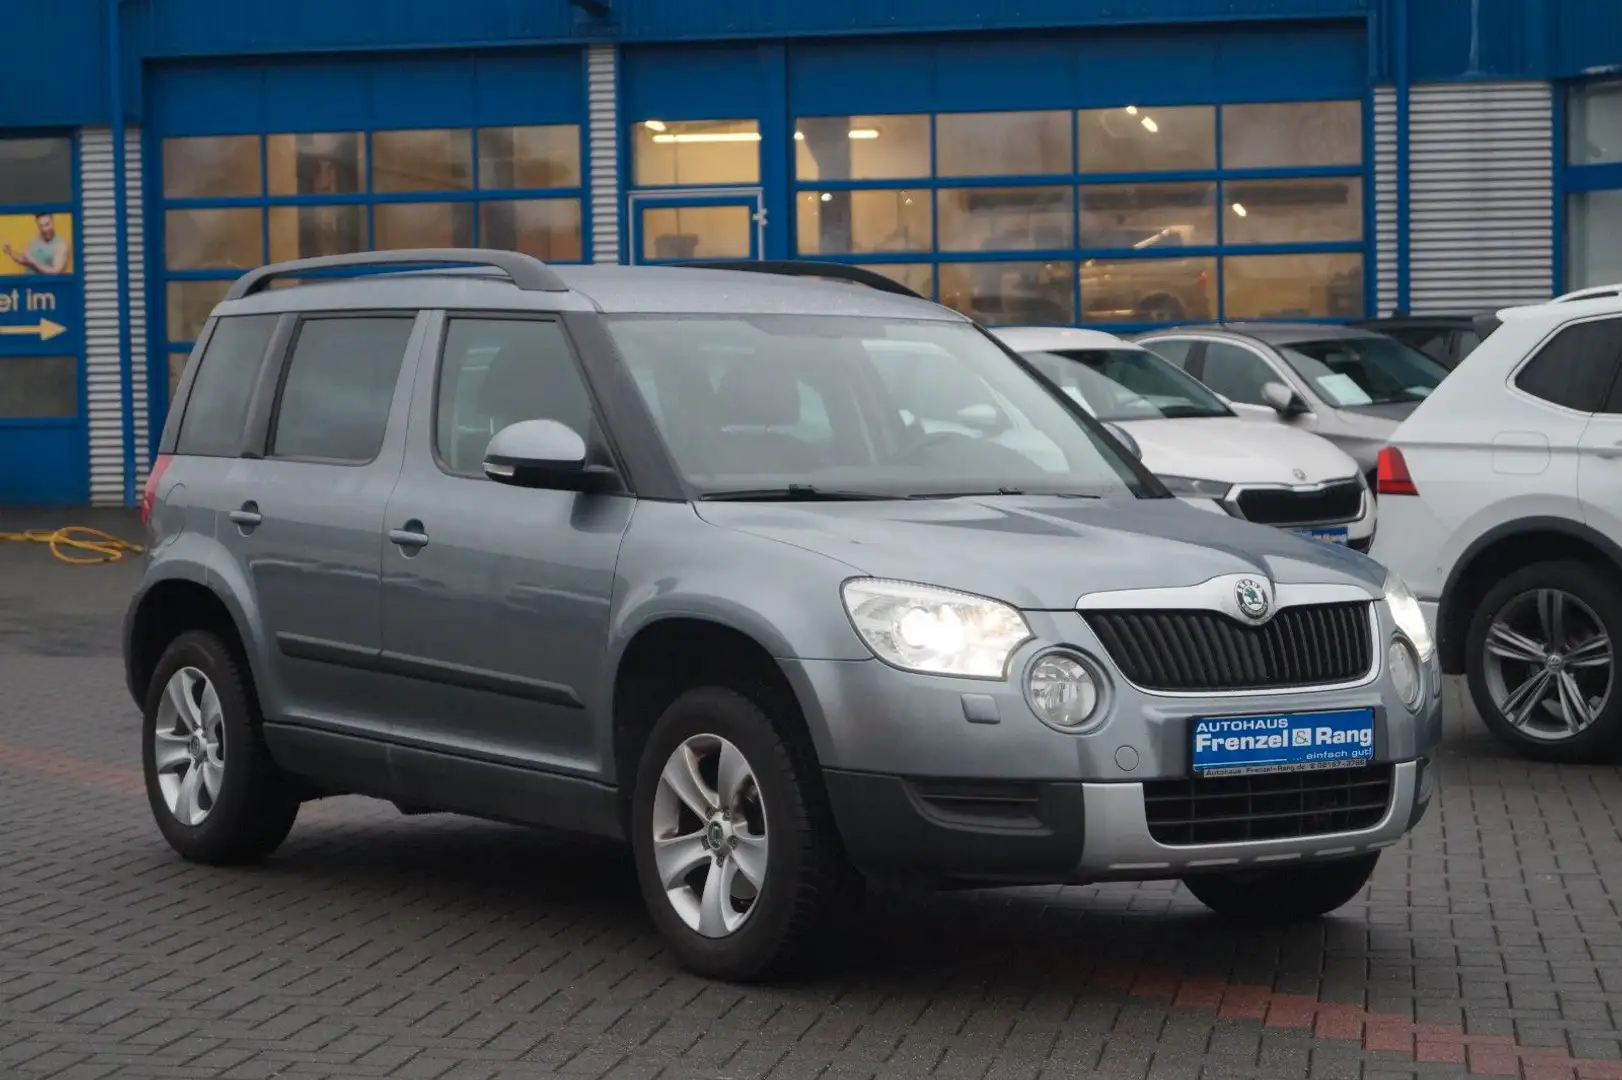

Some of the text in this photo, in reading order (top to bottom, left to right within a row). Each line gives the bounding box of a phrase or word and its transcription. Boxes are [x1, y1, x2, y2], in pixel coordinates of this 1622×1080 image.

[26, 287, 56, 311] im
[1196, 718, 1288, 733] AUTOHAUS
[1196, 727, 1372, 752] Frenzel & Rang
[1306, 750, 1348, 760] einfach
